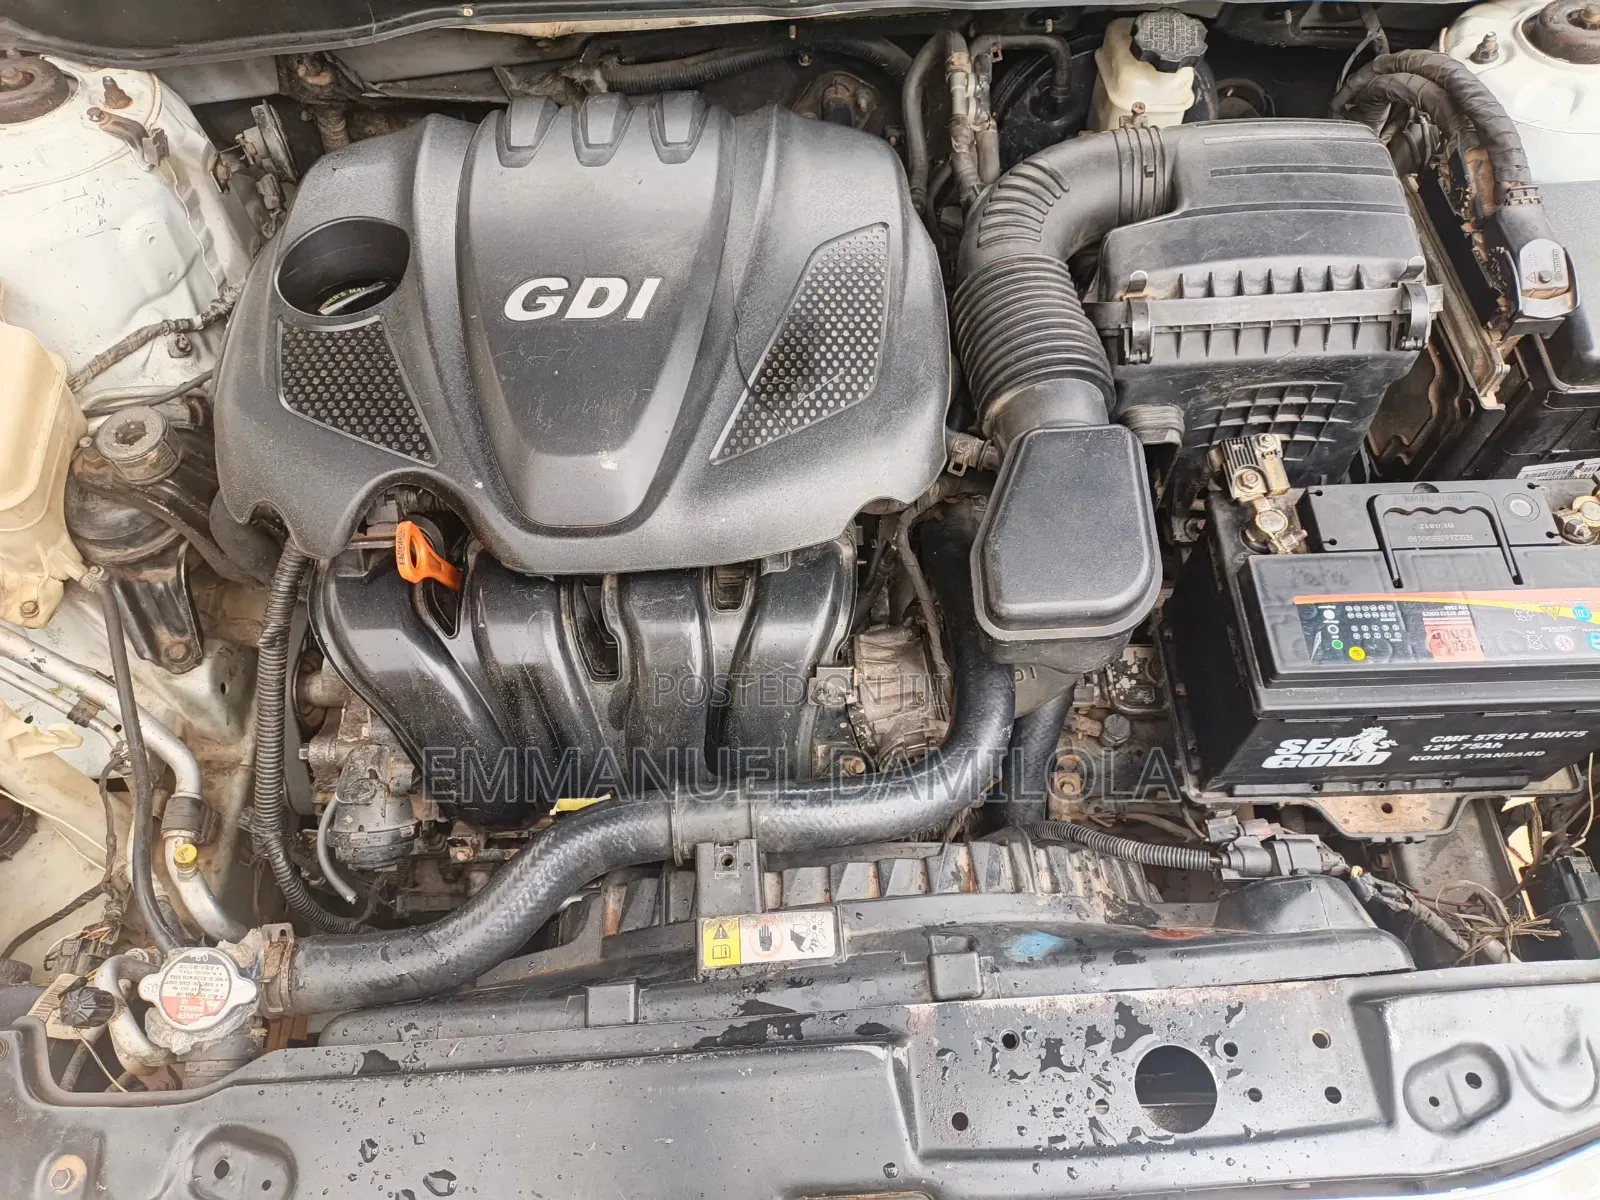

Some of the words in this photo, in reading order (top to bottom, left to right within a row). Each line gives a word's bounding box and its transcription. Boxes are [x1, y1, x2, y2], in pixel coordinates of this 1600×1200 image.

[503, 276, 663, 321] GDI
[1430, 735, 1471, 743] CMF
[1473, 732, 1529, 741] 57512
[1530, 730, 1588, 739] DIN75
[1275, 738, 1350, 754] SEA
[1460, 742, 1504, 750] 75Ah
[1261, 751, 1392, 769] GOLD
[1464, 751, 1546, 760] STANDARD
